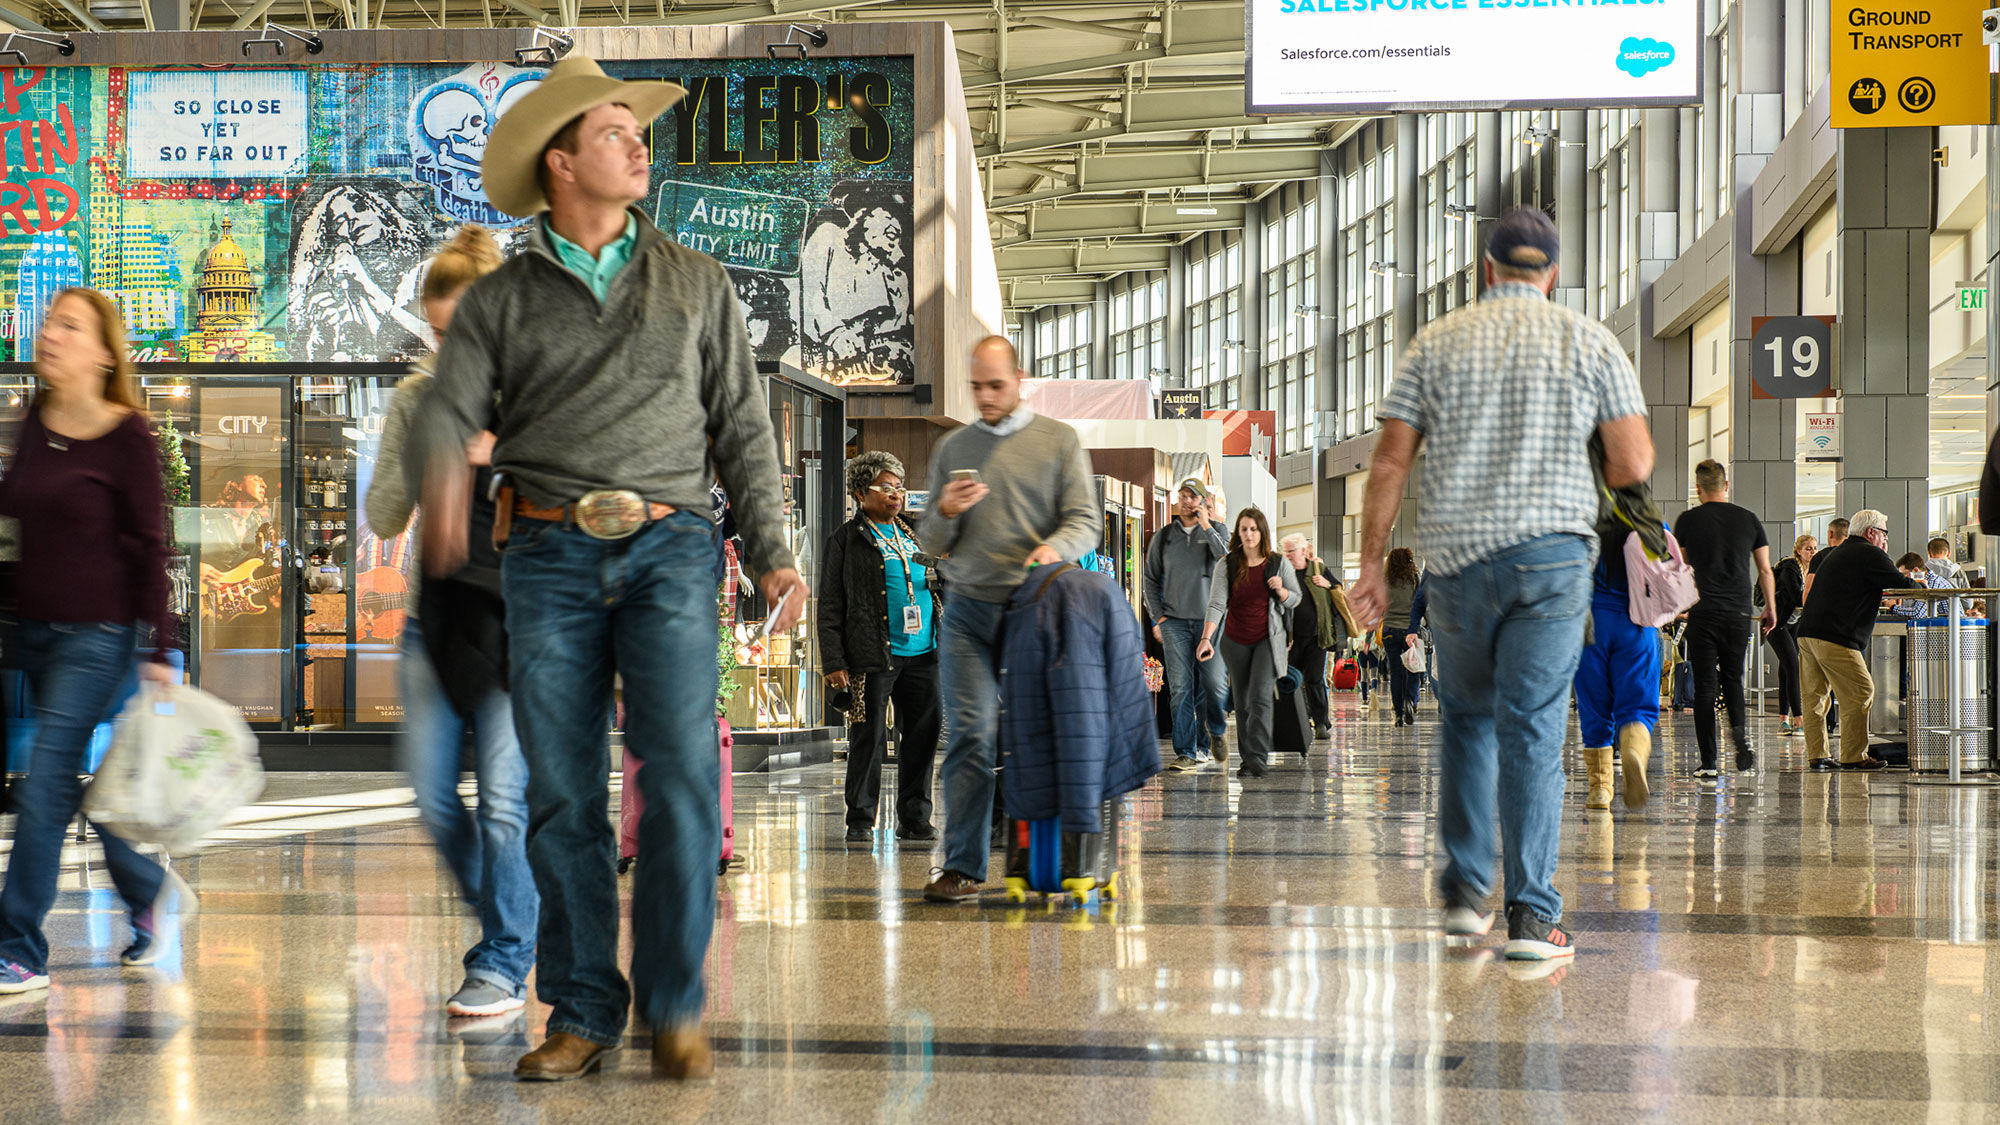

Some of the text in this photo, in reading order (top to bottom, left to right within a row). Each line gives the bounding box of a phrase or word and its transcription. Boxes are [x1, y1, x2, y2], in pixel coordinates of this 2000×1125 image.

[1848, 7, 1932, 27] GROUND
[1848, 32, 1964, 50] TRANSPORT
[1280, 45, 1451, 60] Salesforce.com/essentials
[1623, 50, 1670, 61] salesforce
[0, 66, 46, 115] P
[174, 99, 281, 115] SO CLOSE
[201, 122, 240, 138] YET
[160, 145, 287, 161] SO FAR OUT
[444, 193, 489, 225] death
[688, 197, 776, 233] Austin
[677, 231, 780, 262] CITY LIMIT
[203, 338, 248, 355] 512
[1764, 335, 1820, 378] 19
[1163, 393, 1200, 404] Austin
[218, 415, 268, 434] CITY
[1809, 417, 1836, 426] Wi-Fi
